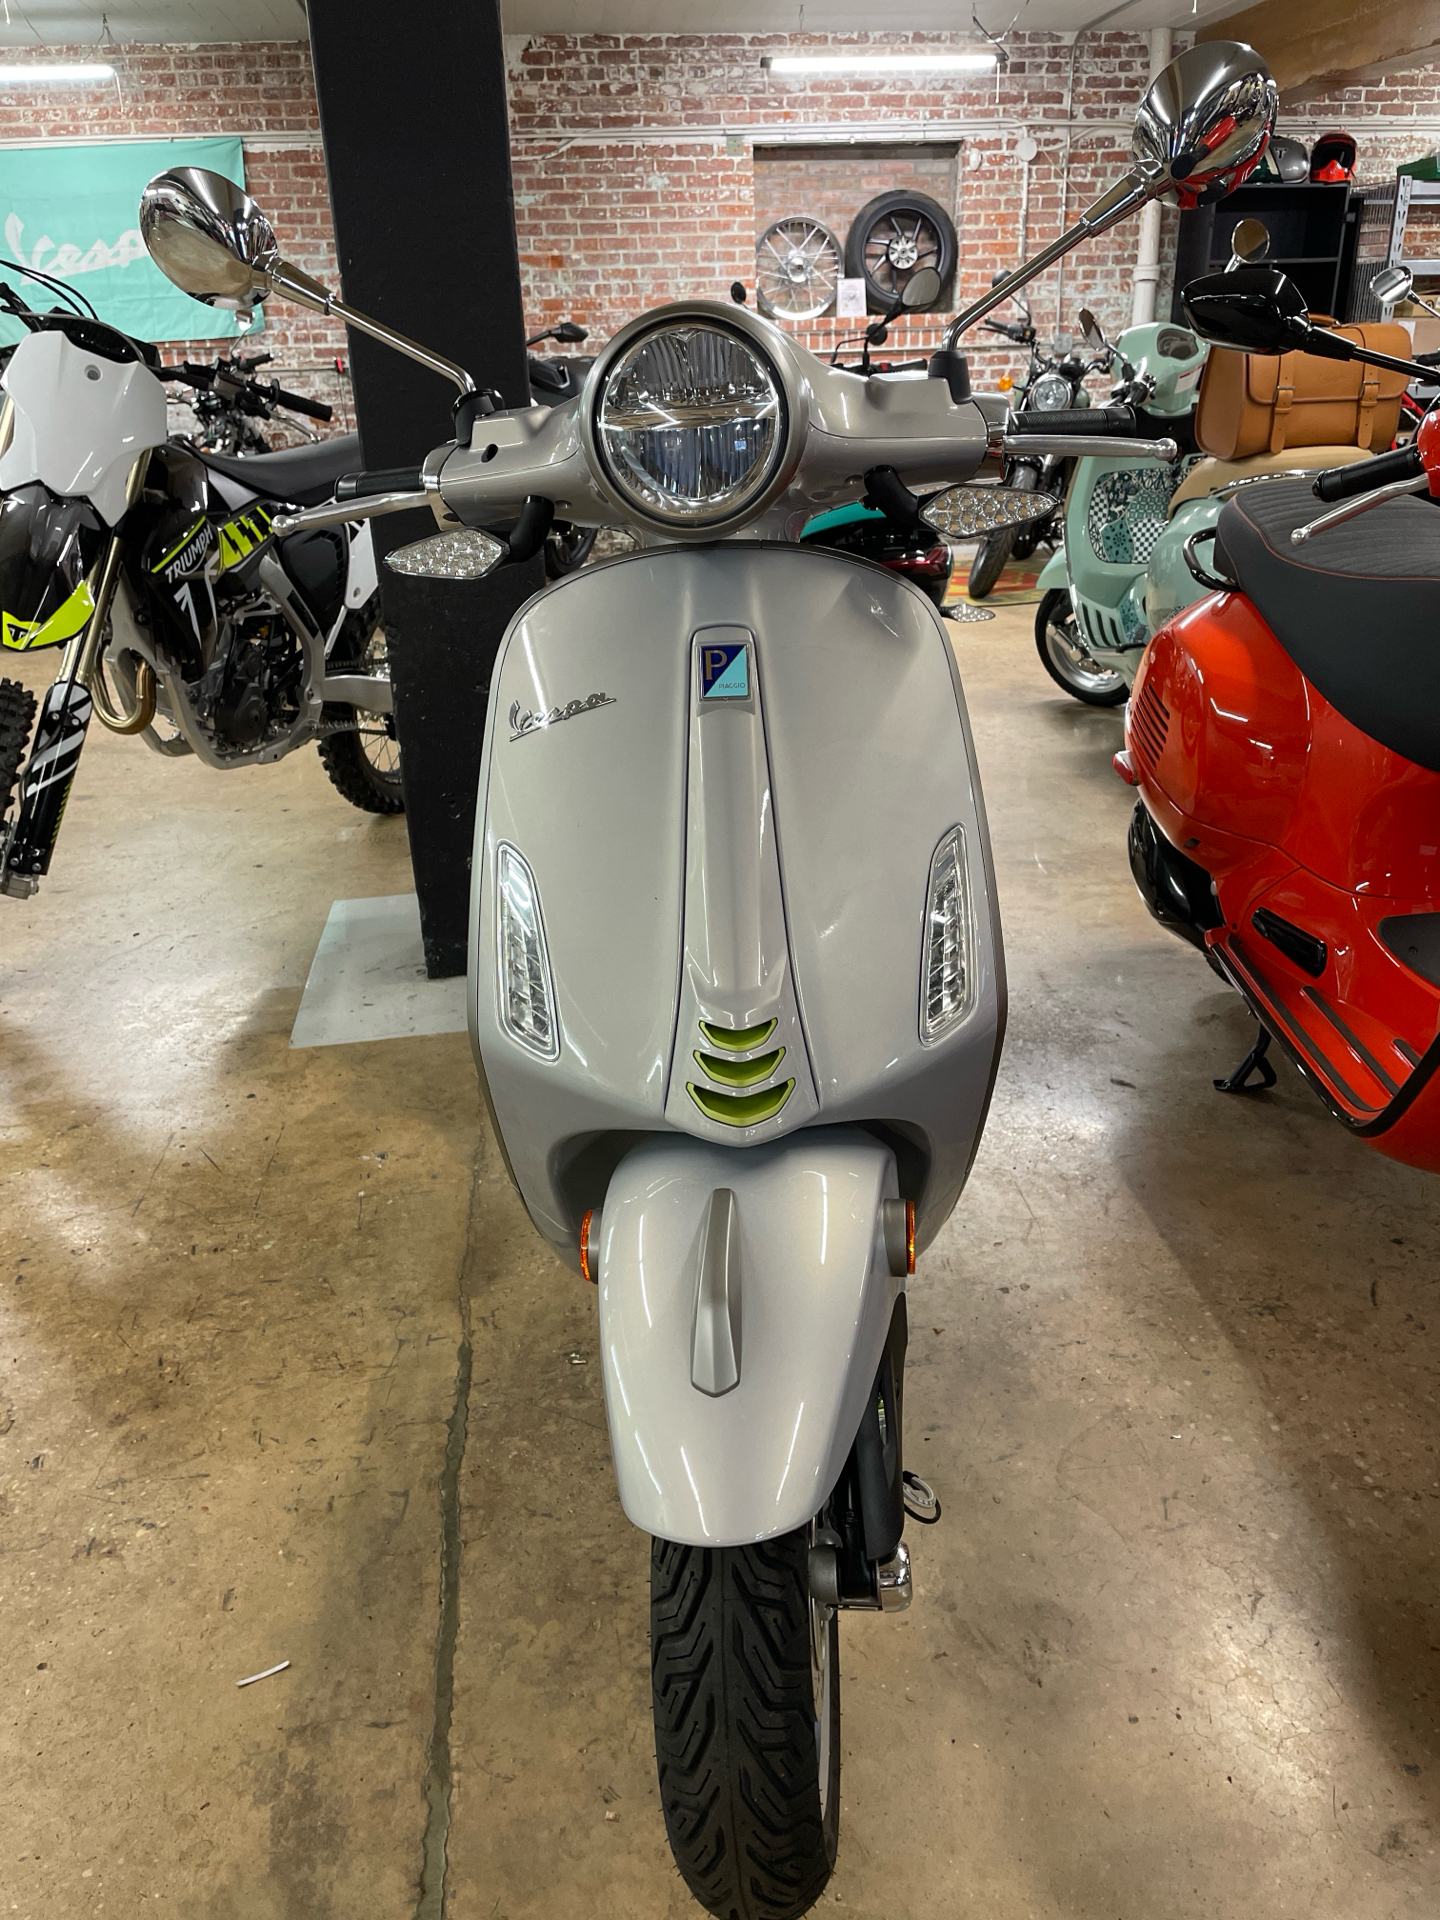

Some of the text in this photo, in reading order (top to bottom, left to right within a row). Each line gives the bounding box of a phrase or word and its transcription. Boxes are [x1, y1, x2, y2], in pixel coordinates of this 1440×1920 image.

[4, 212, 150, 286] Vesp
[165, 524, 213, 584] TRIUMPH
[704, 649, 728, 680] P
[718, 682, 746, 690] PIAGGIO
[508, 692, 617, 742] Vespa
